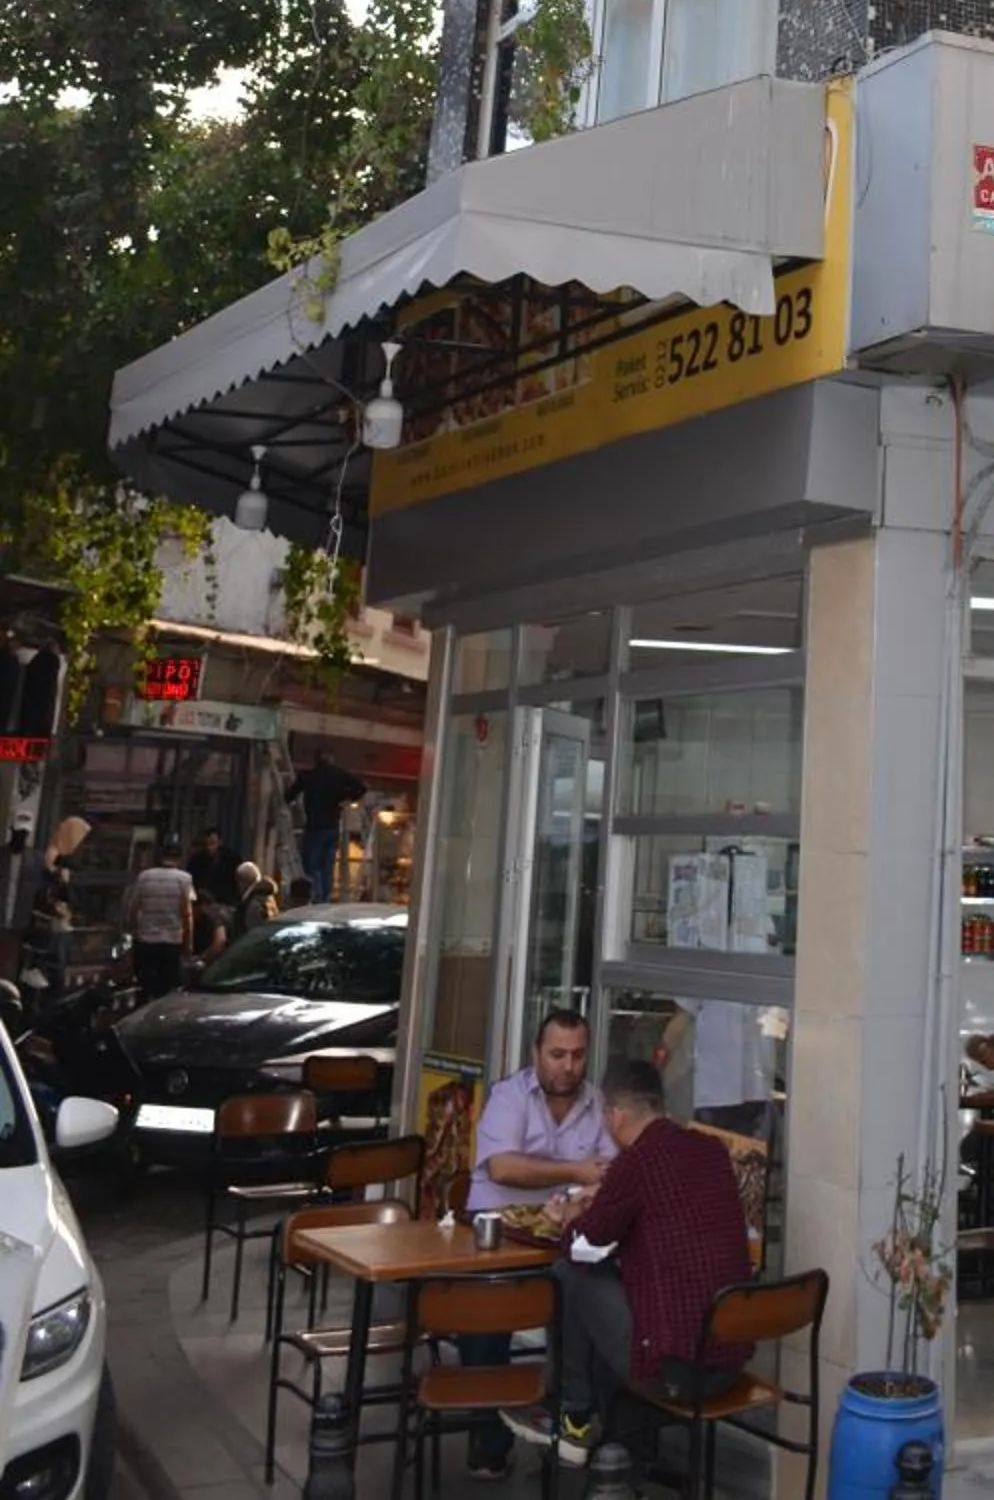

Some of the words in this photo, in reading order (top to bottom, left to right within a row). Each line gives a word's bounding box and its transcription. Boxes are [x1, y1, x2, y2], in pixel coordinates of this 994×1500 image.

[668, 322, 719, 384] 522
[727, 312, 764, 362] 81
[774, 287, 813, 345] 03
